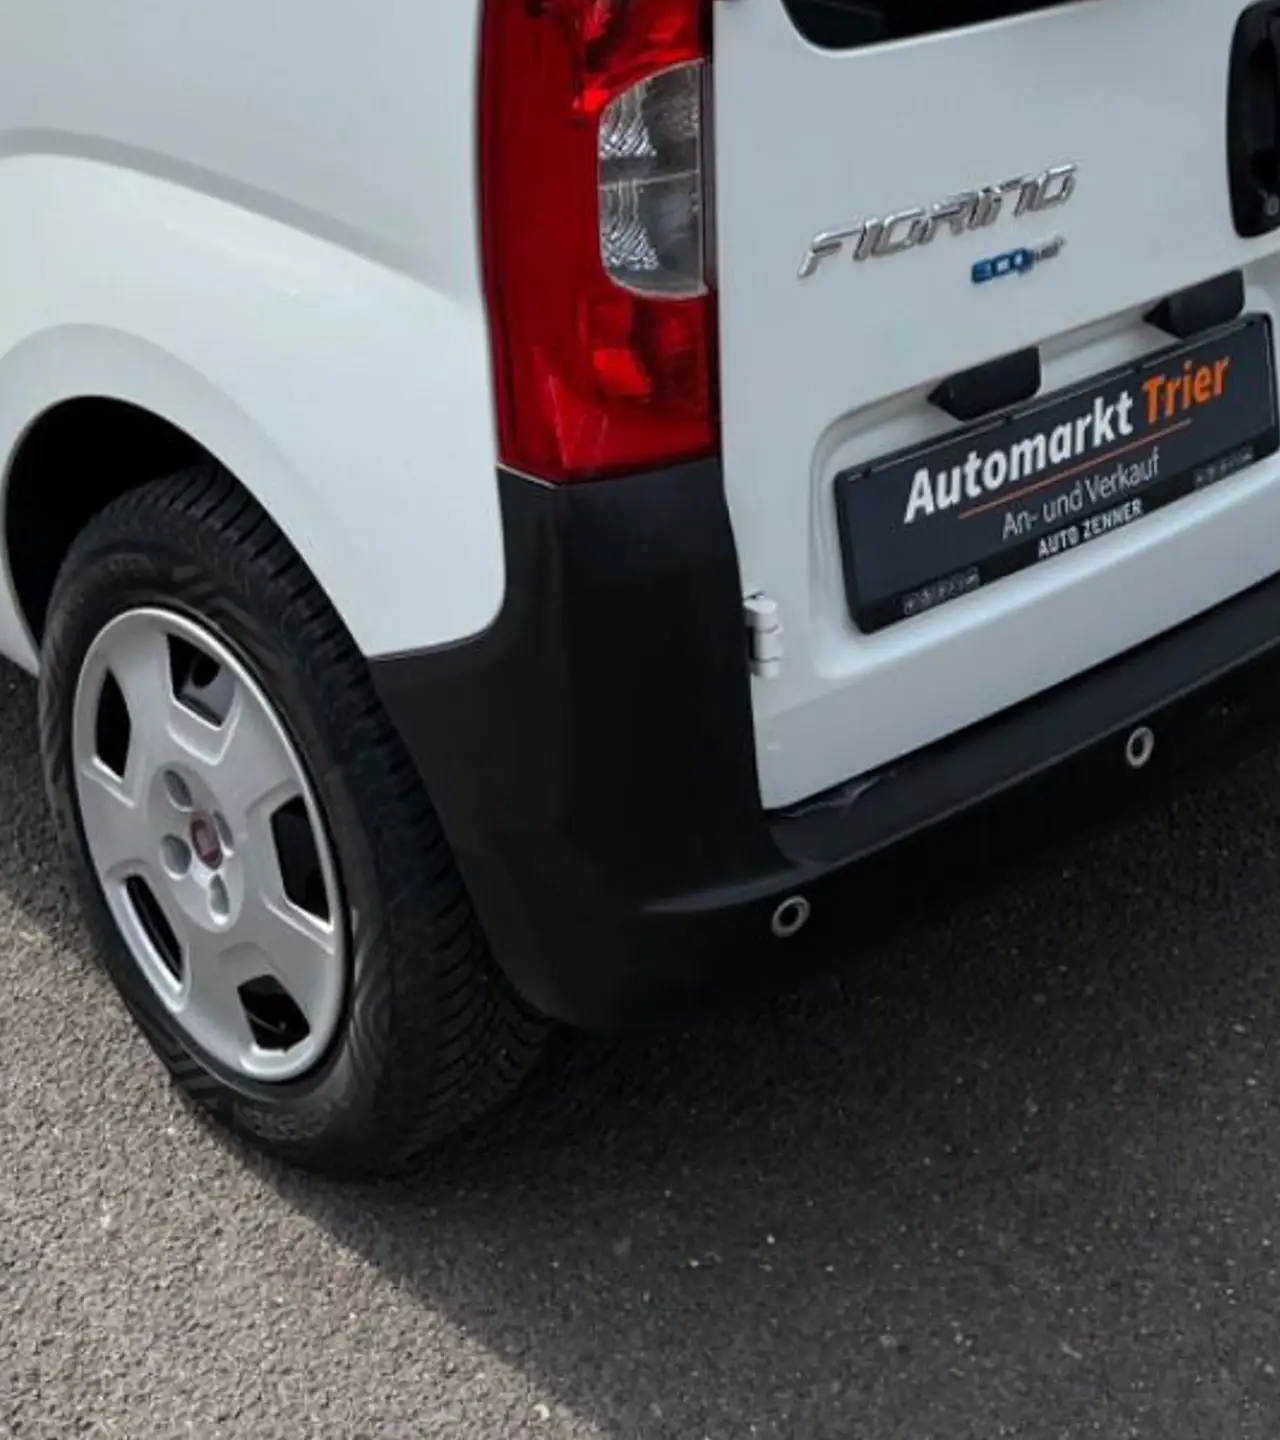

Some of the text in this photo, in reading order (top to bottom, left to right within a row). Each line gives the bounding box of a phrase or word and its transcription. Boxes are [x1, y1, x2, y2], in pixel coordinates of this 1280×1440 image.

[798, 162, 1076, 277] FIORINO
[904, 390, 1133, 524] Automarkt
[1143, 356, 1231, 425] Trier
[1002, 511, 1036, 541] An-
[1043, 485, 1083, 524] und
[1085, 447, 1160, 509] Verkauf
[1038, 497, 1144, 560] AUTO ZENNER
